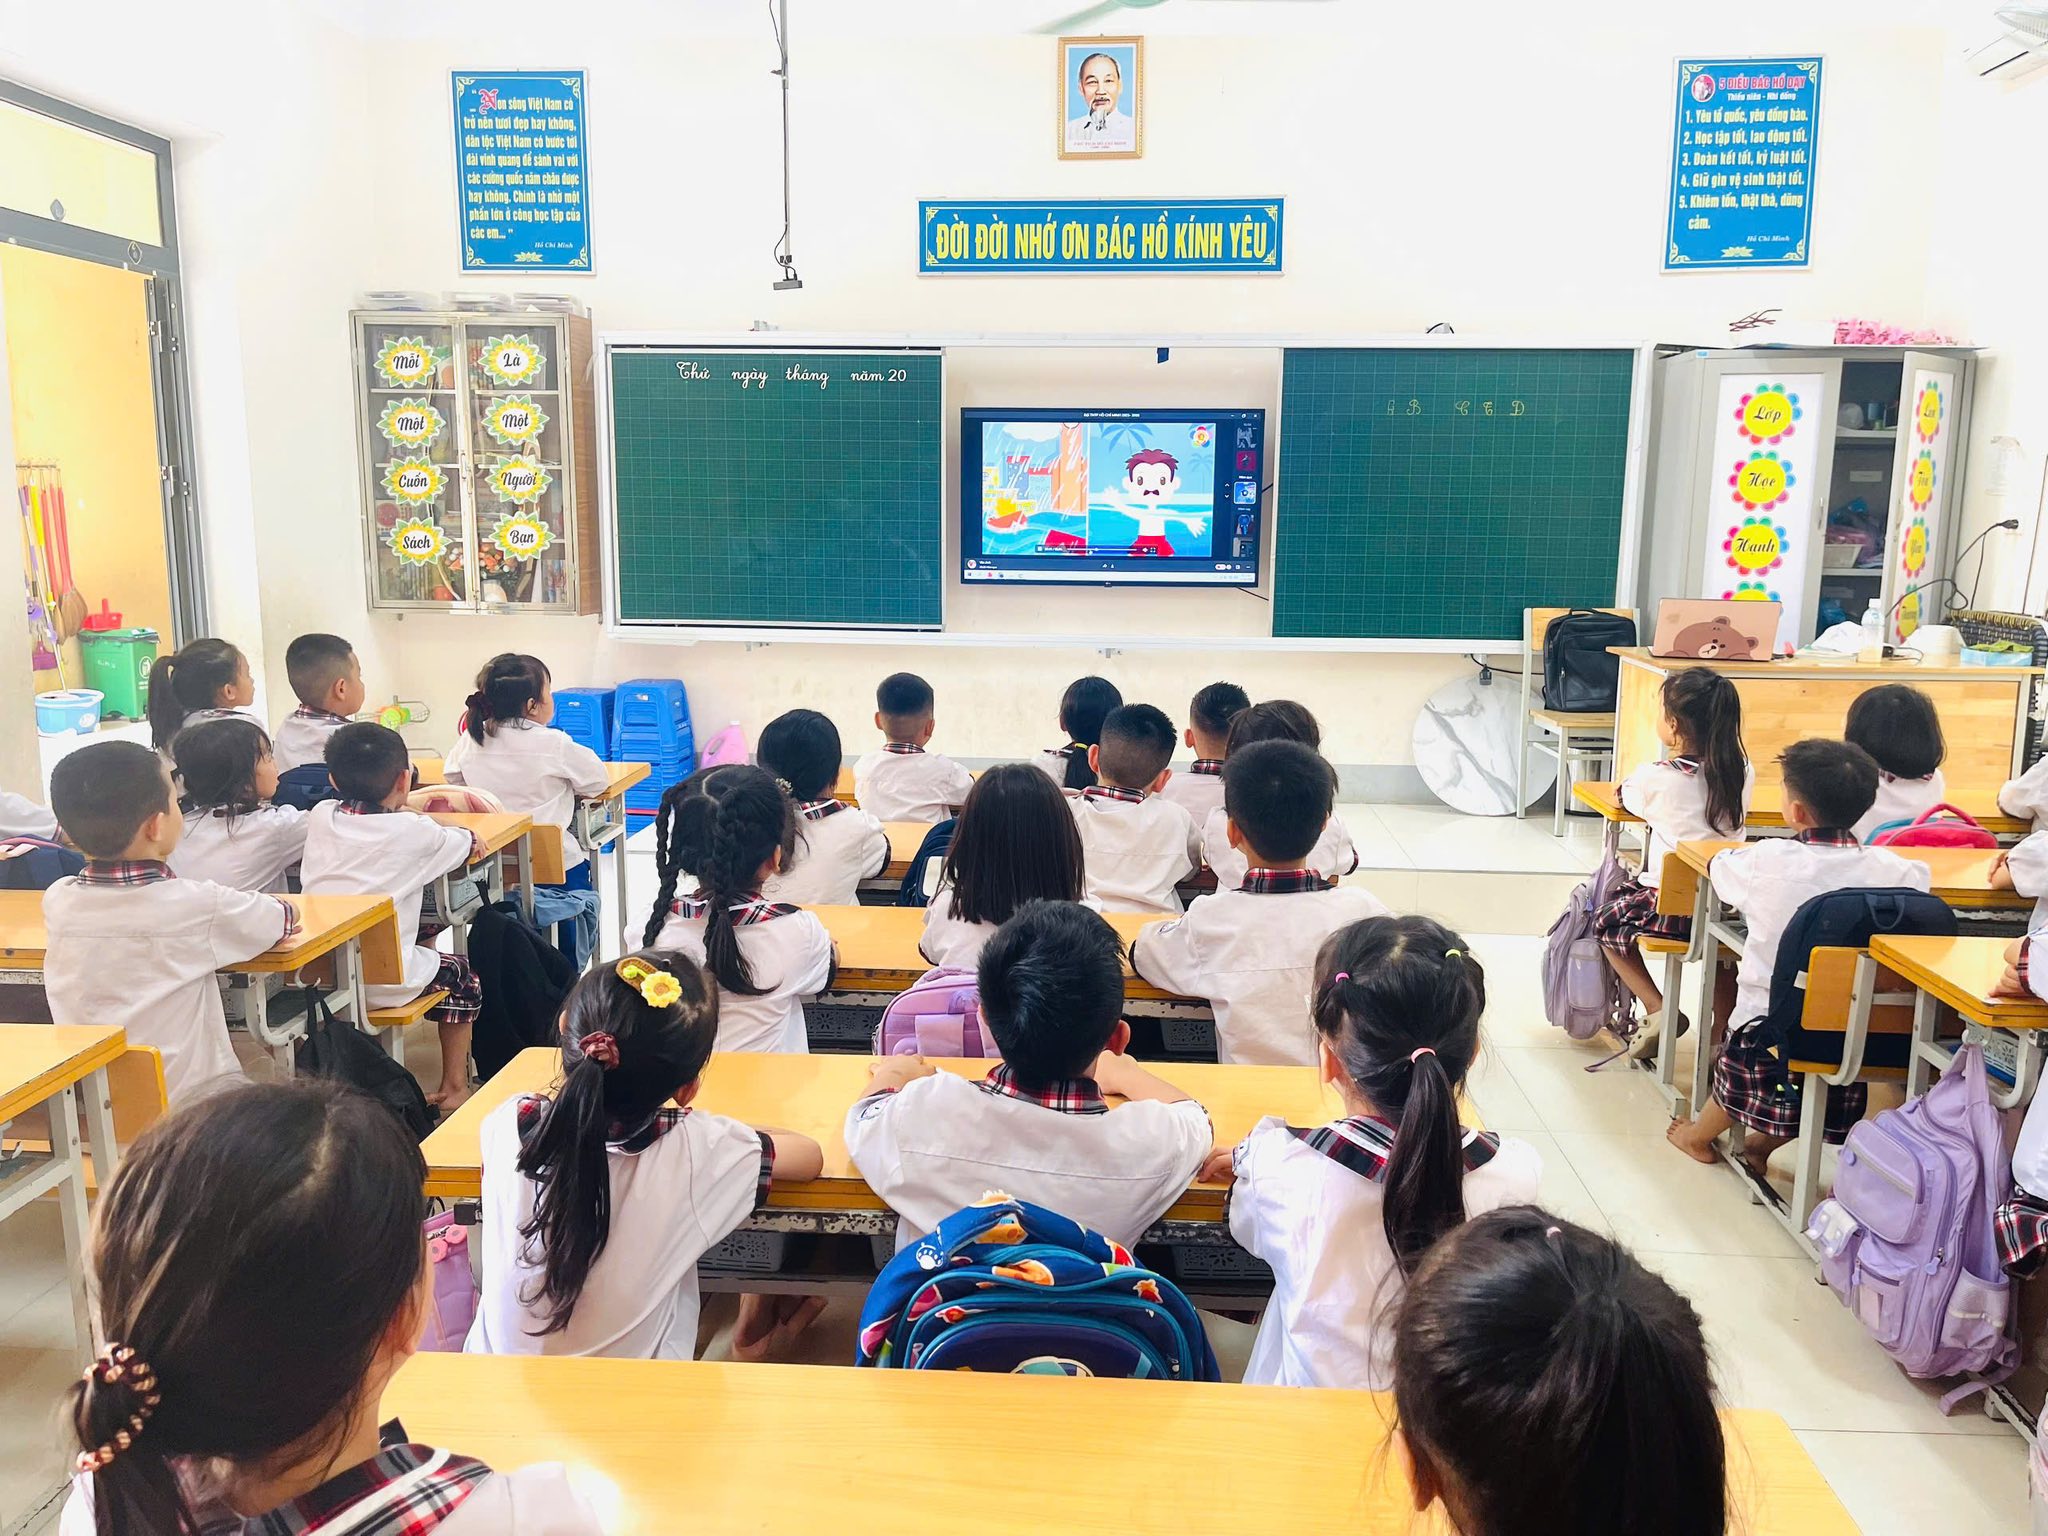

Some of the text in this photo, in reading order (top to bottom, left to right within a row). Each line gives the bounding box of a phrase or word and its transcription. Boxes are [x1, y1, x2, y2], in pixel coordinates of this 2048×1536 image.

[1719, 78, 1726, 90] 5
[1751, 74, 1769, 89] BÁC
[1772, 72, 1786, 89] HỒ
[508, 97, 526, 111] sông
[528, 97, 542, 113] Việt
[545, 97, 562, 110] Nam
[564, 97, 573, 110] có
[478, 117, 493, 129] nên
[514, 117, 529, 132] đẹp
[531, 117, 546, 131] hay
[548, 117, 576, 131] không,
[1686, 110, 1693, 123] 1.
[1696, 109, 1711, 123] Yêu
[1750, 109, 1765, 123] yêu
[465, 135, 480, 147] dân
[482, 135, 494, 150] tộc
[496, 135, 511, 150] Việt
[513, 135, 532, 147] Nam
[534, 135, 543, 148] có
[1683, 131, 1692, 145] 2.
[1695, 131, 1713, 147] Học
[1715, 130, 1730, 147] tập
[1750, 130, 1765, 143] lao
[1767, 129, 1790, 146] động
[480, 153, 496, 166] vinh
[498, 155, 520, 167] quang
[534, 153, 552, 166] sánh
[554, 154, 565, 166] vai
[1682, 152, 1691, 166] 3.
[467, 172, 481, 184] các
[525, 172, 540, 184] năm
[542, 172, 560, 185] châu
[1681, 174, 1690, 187] 4.
[1730, 172, 1741, 189] vệ
[1743, 172, 1764, 186] sinh
[1767, 172, 1786, 188] thật
[468, 190, 483, 204] hay
[484, 189, 511, 204] không.
[538, 190, 546, 203] là
[564, 190, 580, 206] một
[1679, 195, 1687, 208] 5.
[1690, 194, 1719, 208] Khiêm
[1741, 193, 1759, 210] thật
[513, 208, 532, 222] công
[534, 208, 549, 223] học
[551, 208, 564, 224] tập
[566, 207, 581, 221] của
[471, 226, 484, 239] các
[936, 210, 1268, 259] ĐỜI ĐỜI NHỚ ƠN BÁC HỒ KÍNH YÊU
[393, 353, 420, 370] Mỗi
[503, 352, 522, 368] Là
[676, 361, 907, 390] Thứ ngày tháng năm 20
[502, 413, 530, 430] Một
[1753, 405, 1781, 422] Lớp
[397, 417, 425, 434] Một
[398, 471, 429, 488] Cuốn
[500, 471, 538, 492] Người
[1746, 471, 1775, 490] Học
[403, 535, 431, 549] Sách
[509, 530, 534, 547] Bạn
